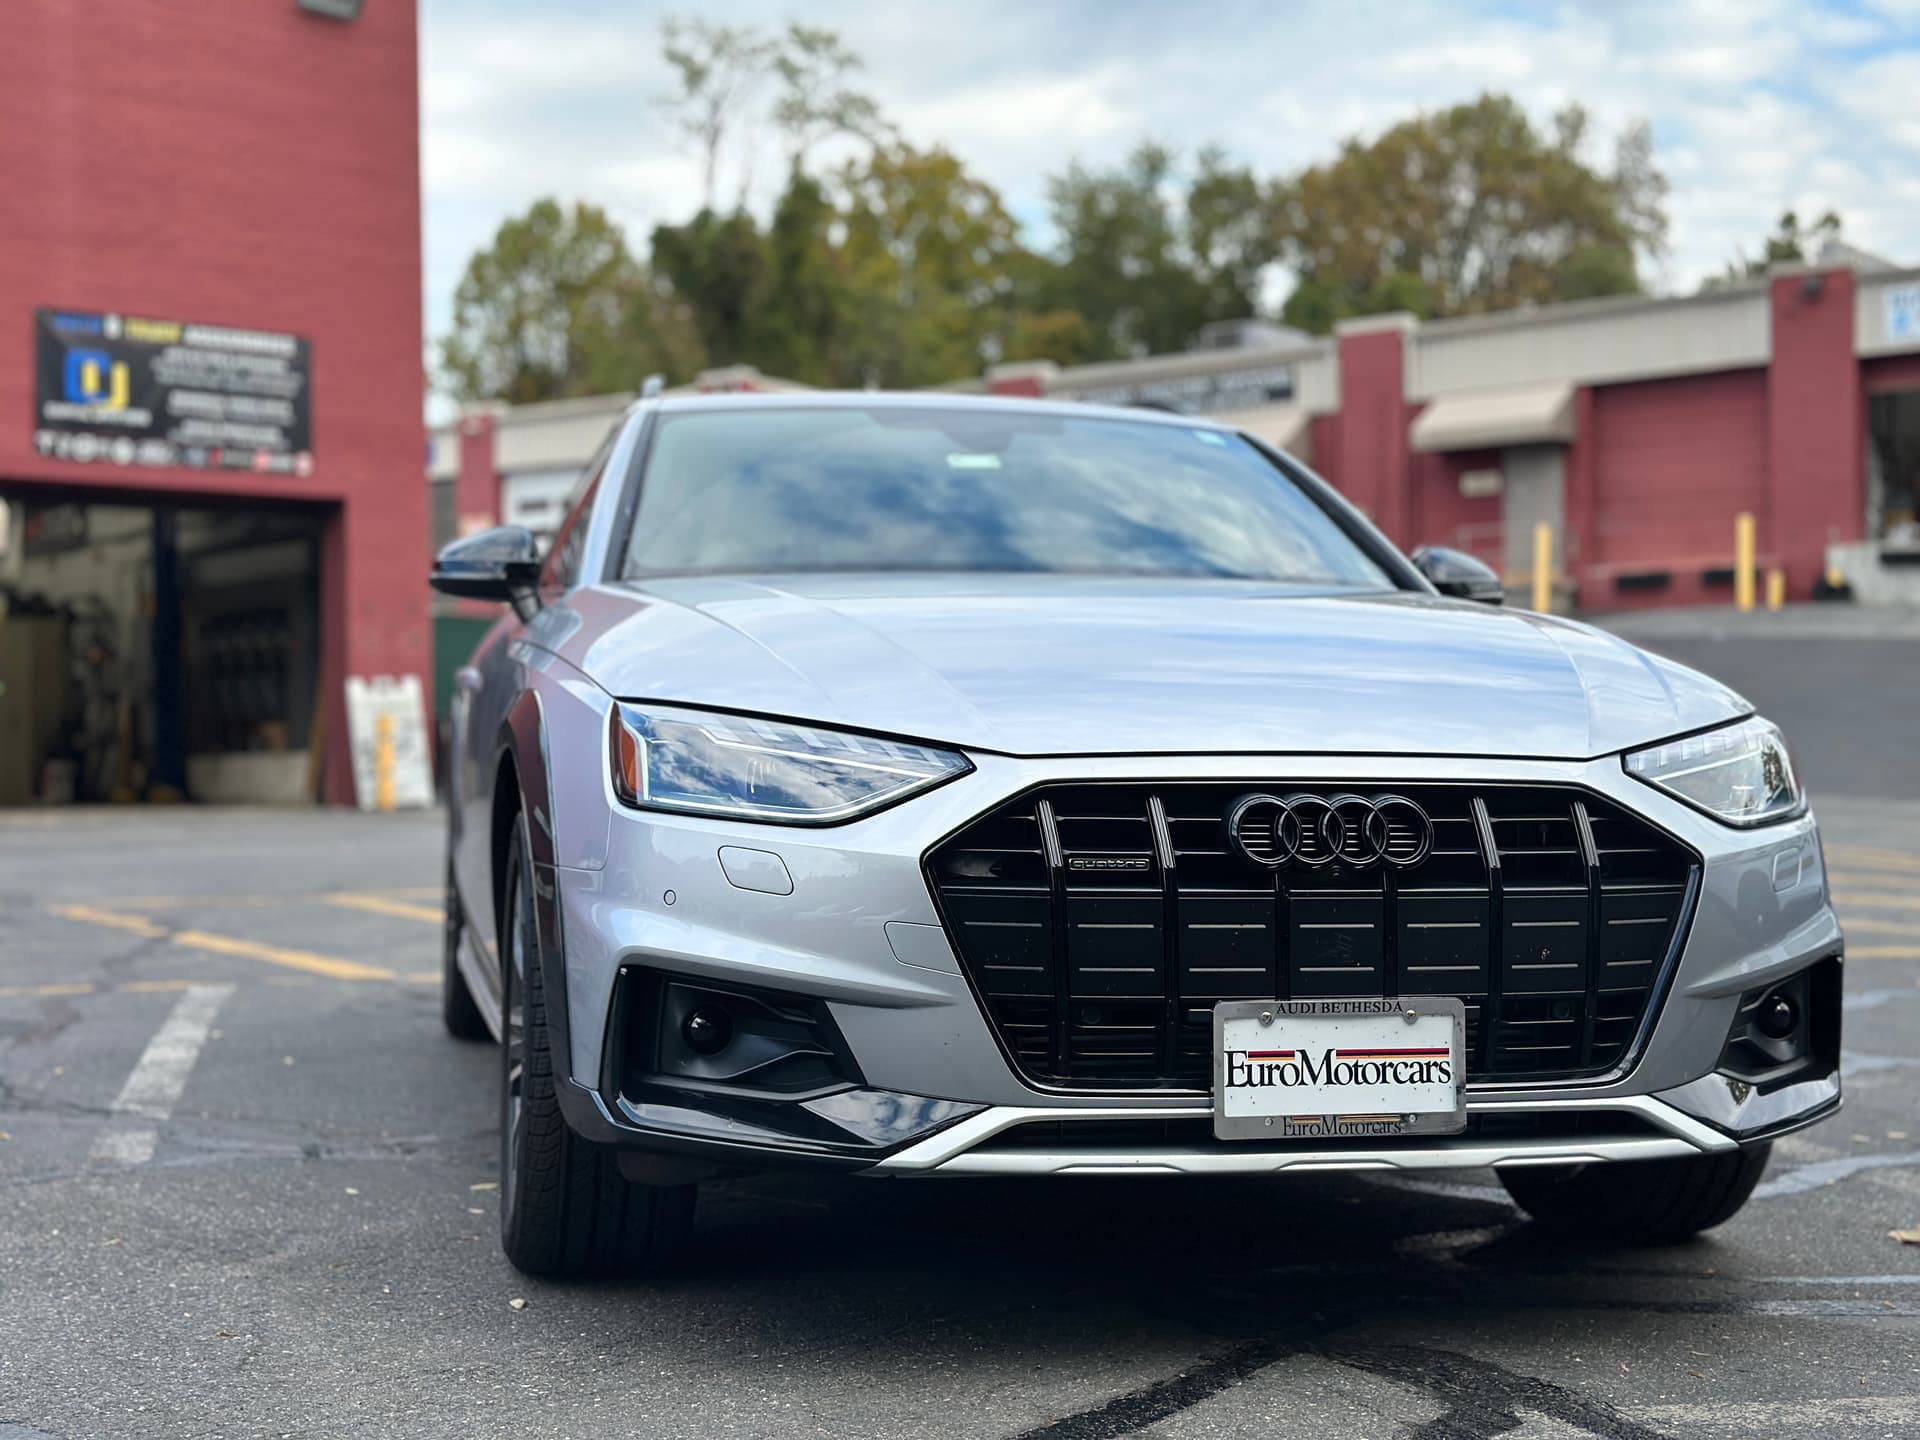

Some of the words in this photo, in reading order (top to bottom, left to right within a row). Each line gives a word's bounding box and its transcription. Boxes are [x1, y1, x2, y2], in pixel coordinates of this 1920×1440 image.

[1072, 859, 1147, 869] quattro
[1276, 1001, 1317, 1015] AUDI
[1321, 1000, 1403, 1014] BETHESDA
[1223, 1048, 1452, 1088] EuroMotorcars
[1282, 1114, 1402, 1137] EuroMotorcars
